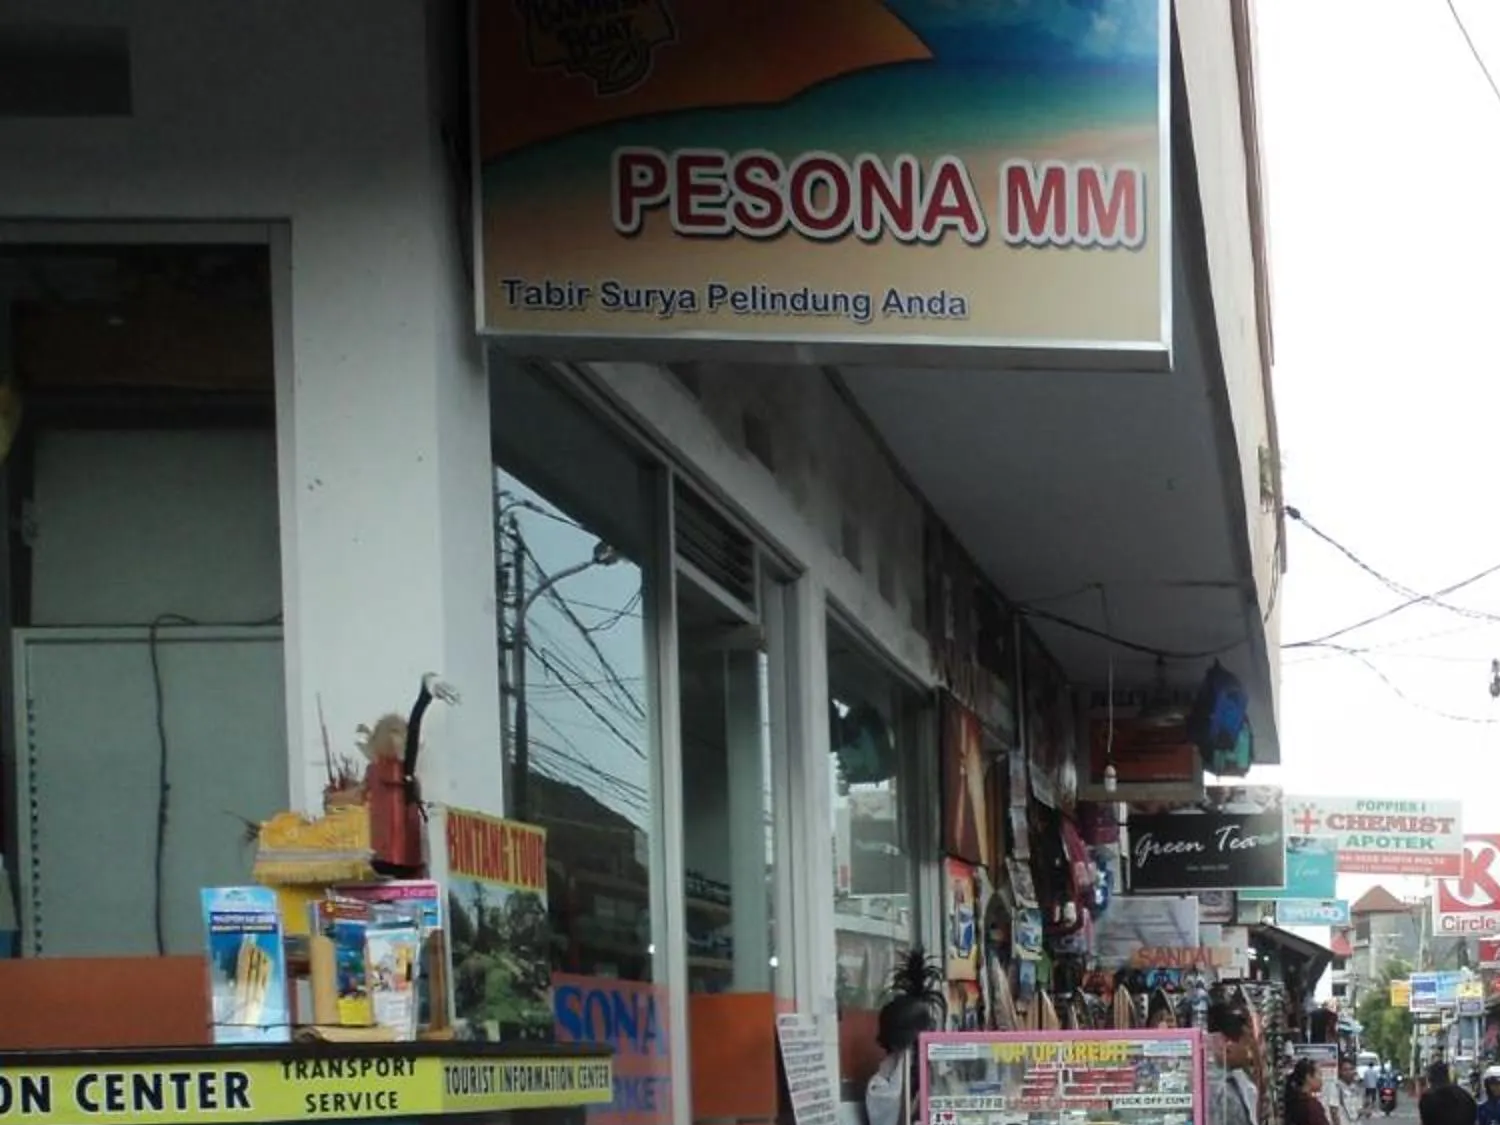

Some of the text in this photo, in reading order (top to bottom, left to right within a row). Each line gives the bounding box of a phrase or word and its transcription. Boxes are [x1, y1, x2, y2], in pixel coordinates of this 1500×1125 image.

[614, 149, 1146, 246] PESONA MM
[502, 279, 967, 321] Tabir Surya Pelindung Anda
[1326, 813, 1455, 834] CHEMIST
[1135, 825, 1261, 868] Green Tea
[1346, 835, 1434, 849] APOTEK
[1441, 915, 1497, 931] Circle
[1138, 947, 1216, 967] SANDAL
[281, 1056, 418, 1081] TRANSPORT
[444, 1064, 609, 1095] TOURIST INFORMATION CENTER
[75, 1071, 252, 1112] CENTER
[304, 1090, 399, 1113] SERVICE
